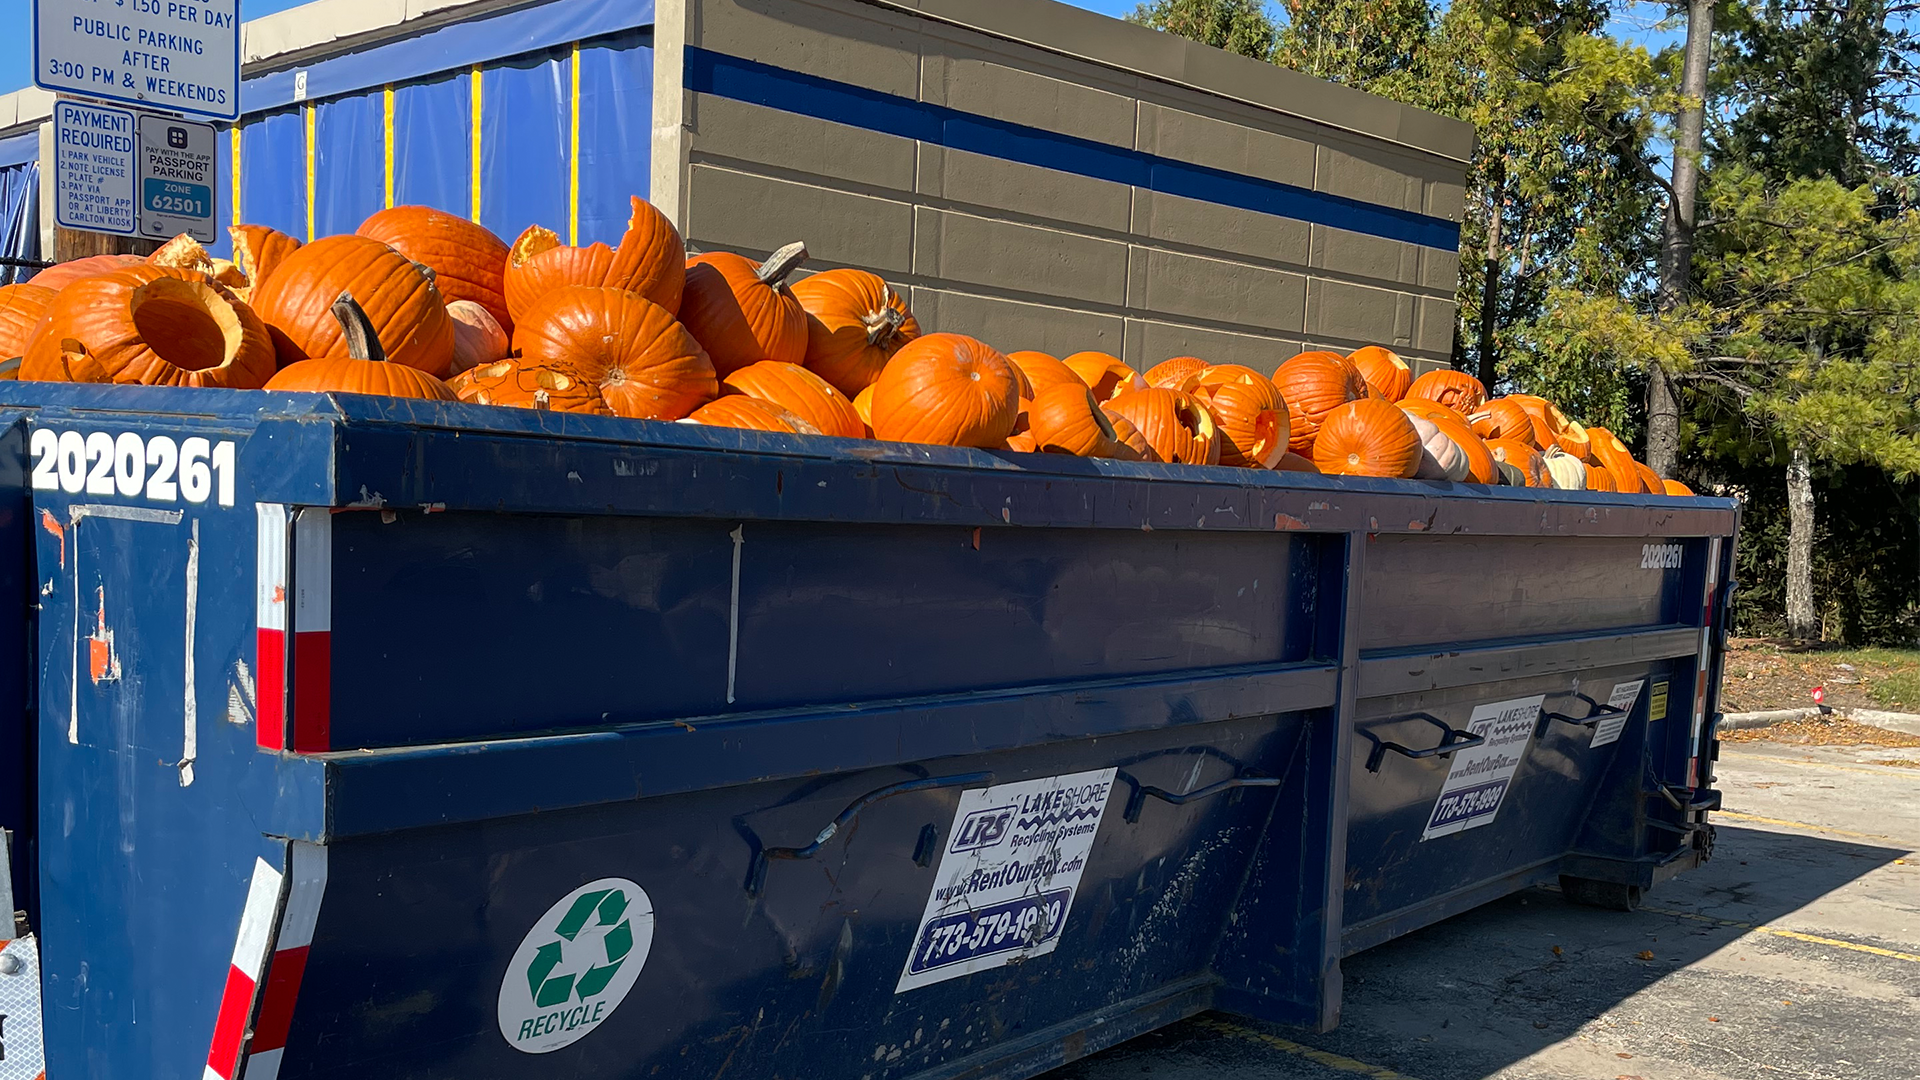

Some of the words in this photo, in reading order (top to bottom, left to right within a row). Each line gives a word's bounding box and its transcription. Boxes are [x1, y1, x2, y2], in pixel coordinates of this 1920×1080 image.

[133, 0, 161, 15] 1.50
[168, 2, 197, 23] PER
[204, 9, 233, 29] DAY
[73, 16, 131, 42] PUBLIC
[138, 29, 203, 55] PARKING
[122, 50, 170, 73] AFTER
[49, 59, 84, 79] 3:00
[92, 66, 114, 85] PM
[122, 72, 135, 89] &
[146, 76, 226, 104] WEEKENDS
[297, 75, 305, 90] G
[64, 108, 129, 132] PAYMENT
[61, 128, 132, 153] REQUIRED
[68, 150, 89, 162] PARK
[92, 154, 125, 167] VEHICLE
[145, 146, 159, 154] PAY
[160, 148, 179, 157] WITH
[180, 152, 194, 160] THE
[196, 154, 211, 162] APP
[149, 155, 210, 172] PASSPORT
[60, 161, 67, 169] 2.
[68, 162, 89, 173] NOTE
[92, 165, 126, 178] LICENSE
[68, 172, 93, 183] PLATE
[97, 176, 105, 184] #
[153, 166, 203, 181] PARKING
[60, 181, 67, 190] 3.
[68, 182, 84, 191] PAY
[87, 184, 101, 194] VIA
[164, 183, 191, 195] ZONE
[68, 192, 110, 205] PASSPORT
[114, 198, 131, 208] APP
[68, 201, 80, 211] OR
[84, 203, 94, 213] AT
[152, 194, 202, 214] 62501
[69, 211, 105, 224] CARLTON
[107, 216, 131, 228] KIOSK
[30, 428, 236, 508] 2020261
[1641, 543, 1683, 569] 2020261
[1450, 754, 1519, 780] www.RentOurBox.com
[1021, 782, 1110, 814] LAKESHORE
[1434, 785, 1503, 822] 773-579-1999
[1010, 829, 1056, 848] Recycling
[1056, 822, 1096, 841] Systems
[935, 856, 1084, 901] www.RentOurBox.com
[517, 1000, 607, 1042] RECYCLE
